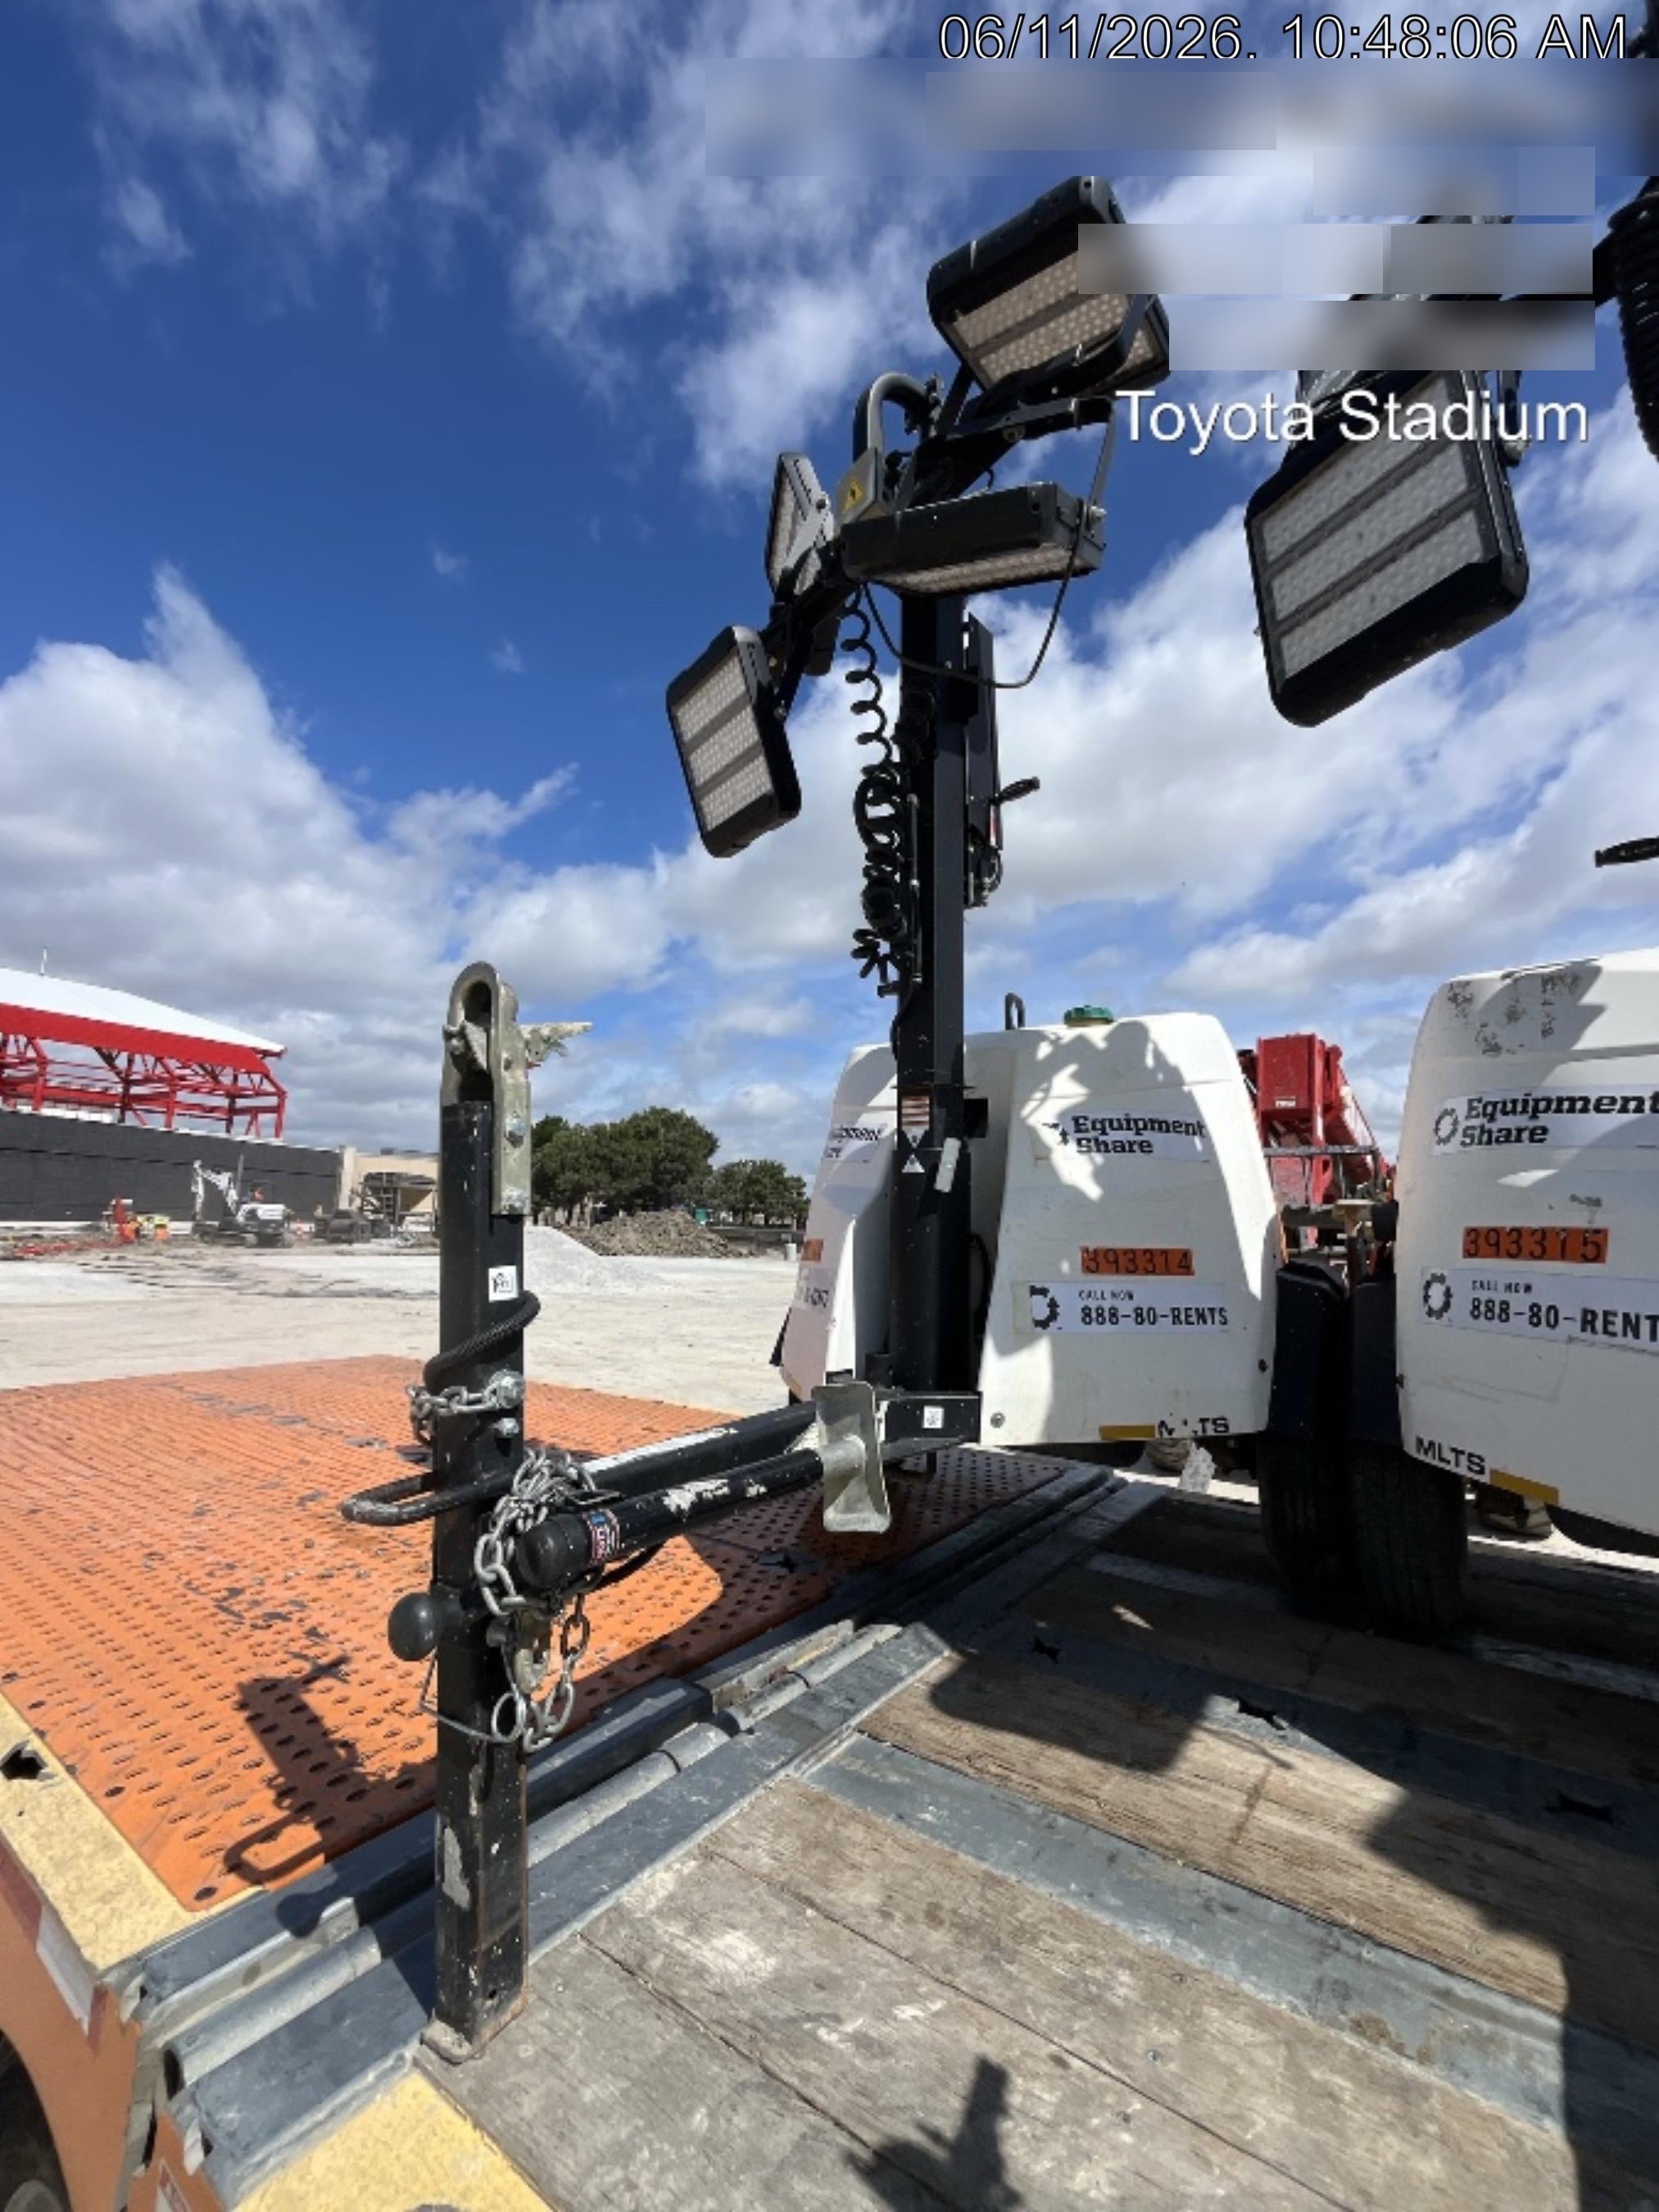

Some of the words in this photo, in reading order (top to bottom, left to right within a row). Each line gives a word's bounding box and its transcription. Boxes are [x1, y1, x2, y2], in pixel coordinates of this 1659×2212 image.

[1464, 1092, 1659, 1123] Equipment
[1071, 1113, 1206, 1138] Equipment
[1459, 1124, 1549, 1147] Share
[1076, 1135, 1154, 1154] Share
[1465, 1227, 1603, 1262] 393315
[1081, 1247, 1193, 1274] 393314
[1078, 1290, 1107, 1301] CALL
[1110, 1290, 1135, 1301] NOW
[1080, 1304, 1229, 1326] 888-80-RENTS
[1469, 1296, 1659, 1343] 888-80-RENT
[1415, 1435, 1486, 1475] MLTS
